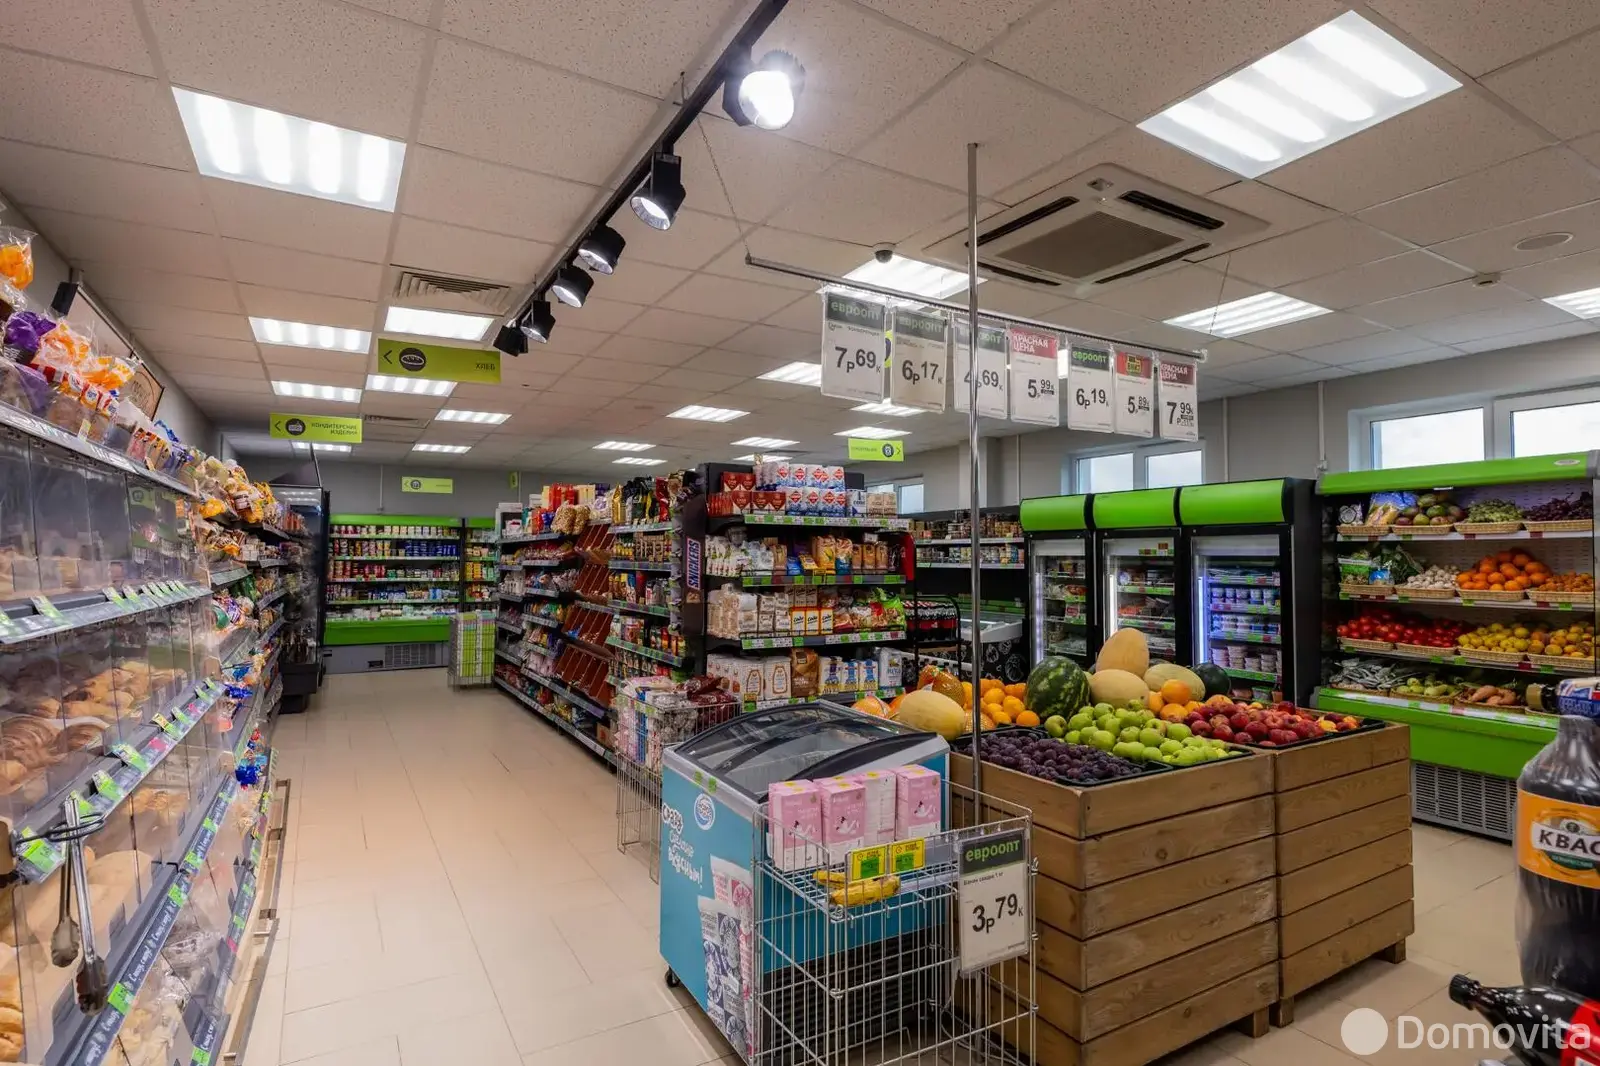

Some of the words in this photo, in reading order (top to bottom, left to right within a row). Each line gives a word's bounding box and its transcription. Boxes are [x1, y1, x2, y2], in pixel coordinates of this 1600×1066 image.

[476, 362, 496, 371] ХЛЕБ
[1072, 350, 1107, 363] евроопт
[688, 539, 700, 589] SNICKERS
[966, 839, 1020, 863] евроопт
[1539, 829, 1600, 857] КВАС
